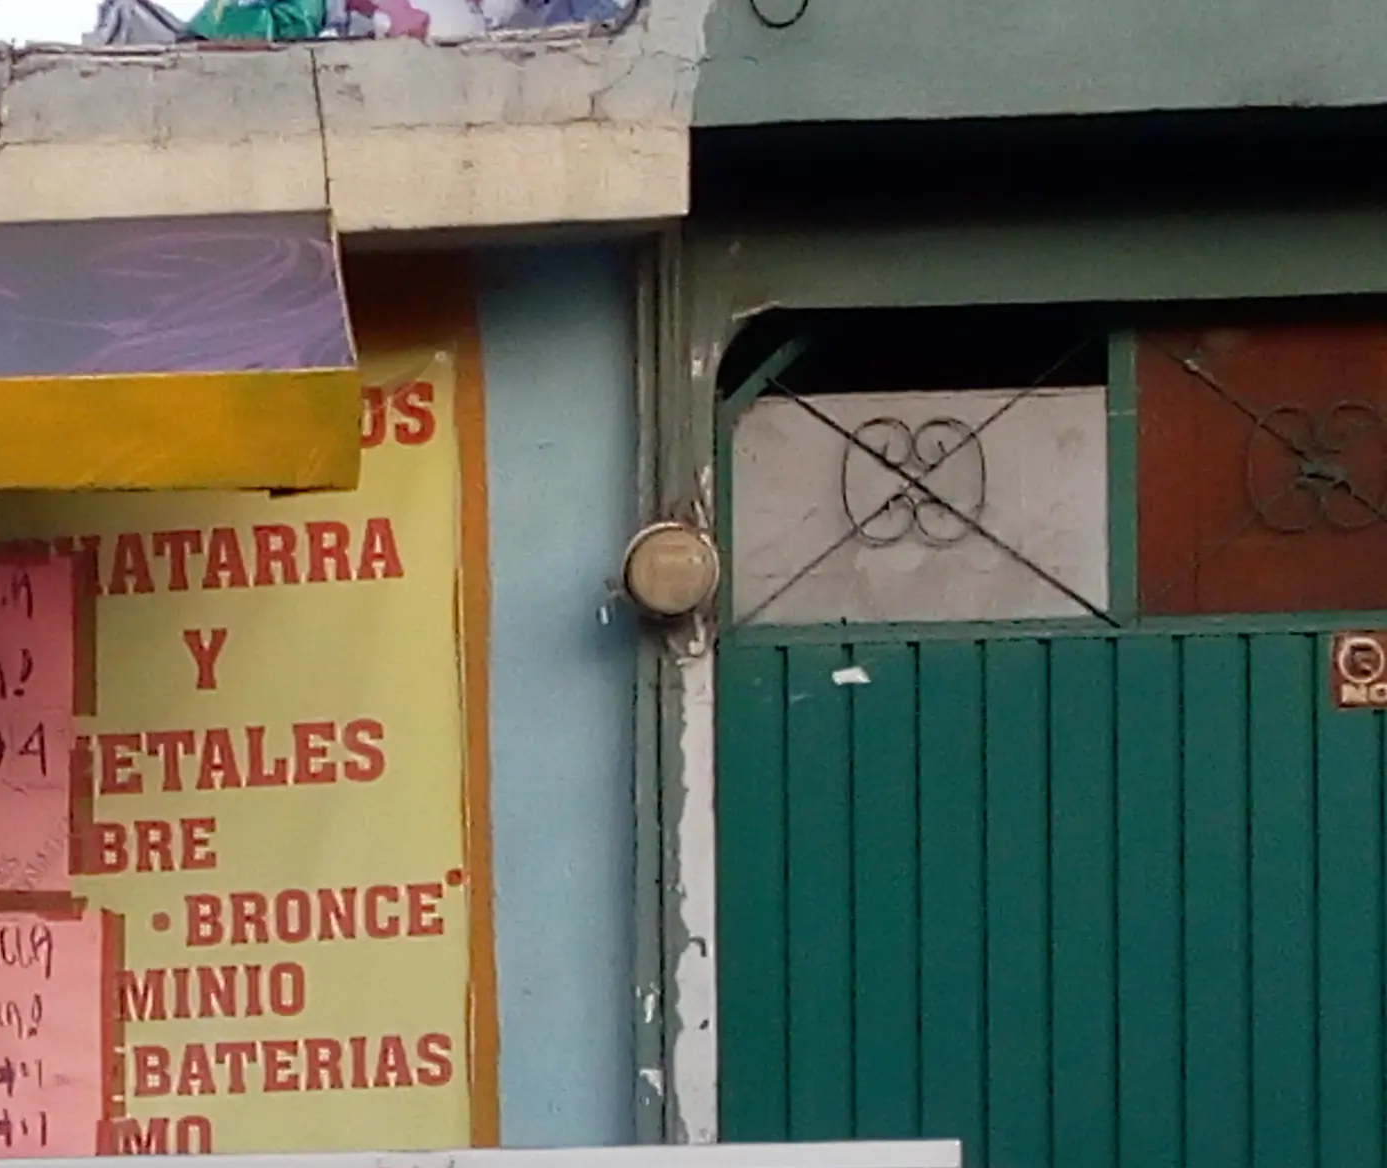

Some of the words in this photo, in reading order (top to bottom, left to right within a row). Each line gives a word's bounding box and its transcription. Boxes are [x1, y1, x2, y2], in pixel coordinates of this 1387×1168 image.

[183, 628, 228, 689] Y
[75, 717, 386, 797] ETALES
[184, 883, 445, 947] BRONCE
[132, 1032, 454, 1098] BATERIAS
